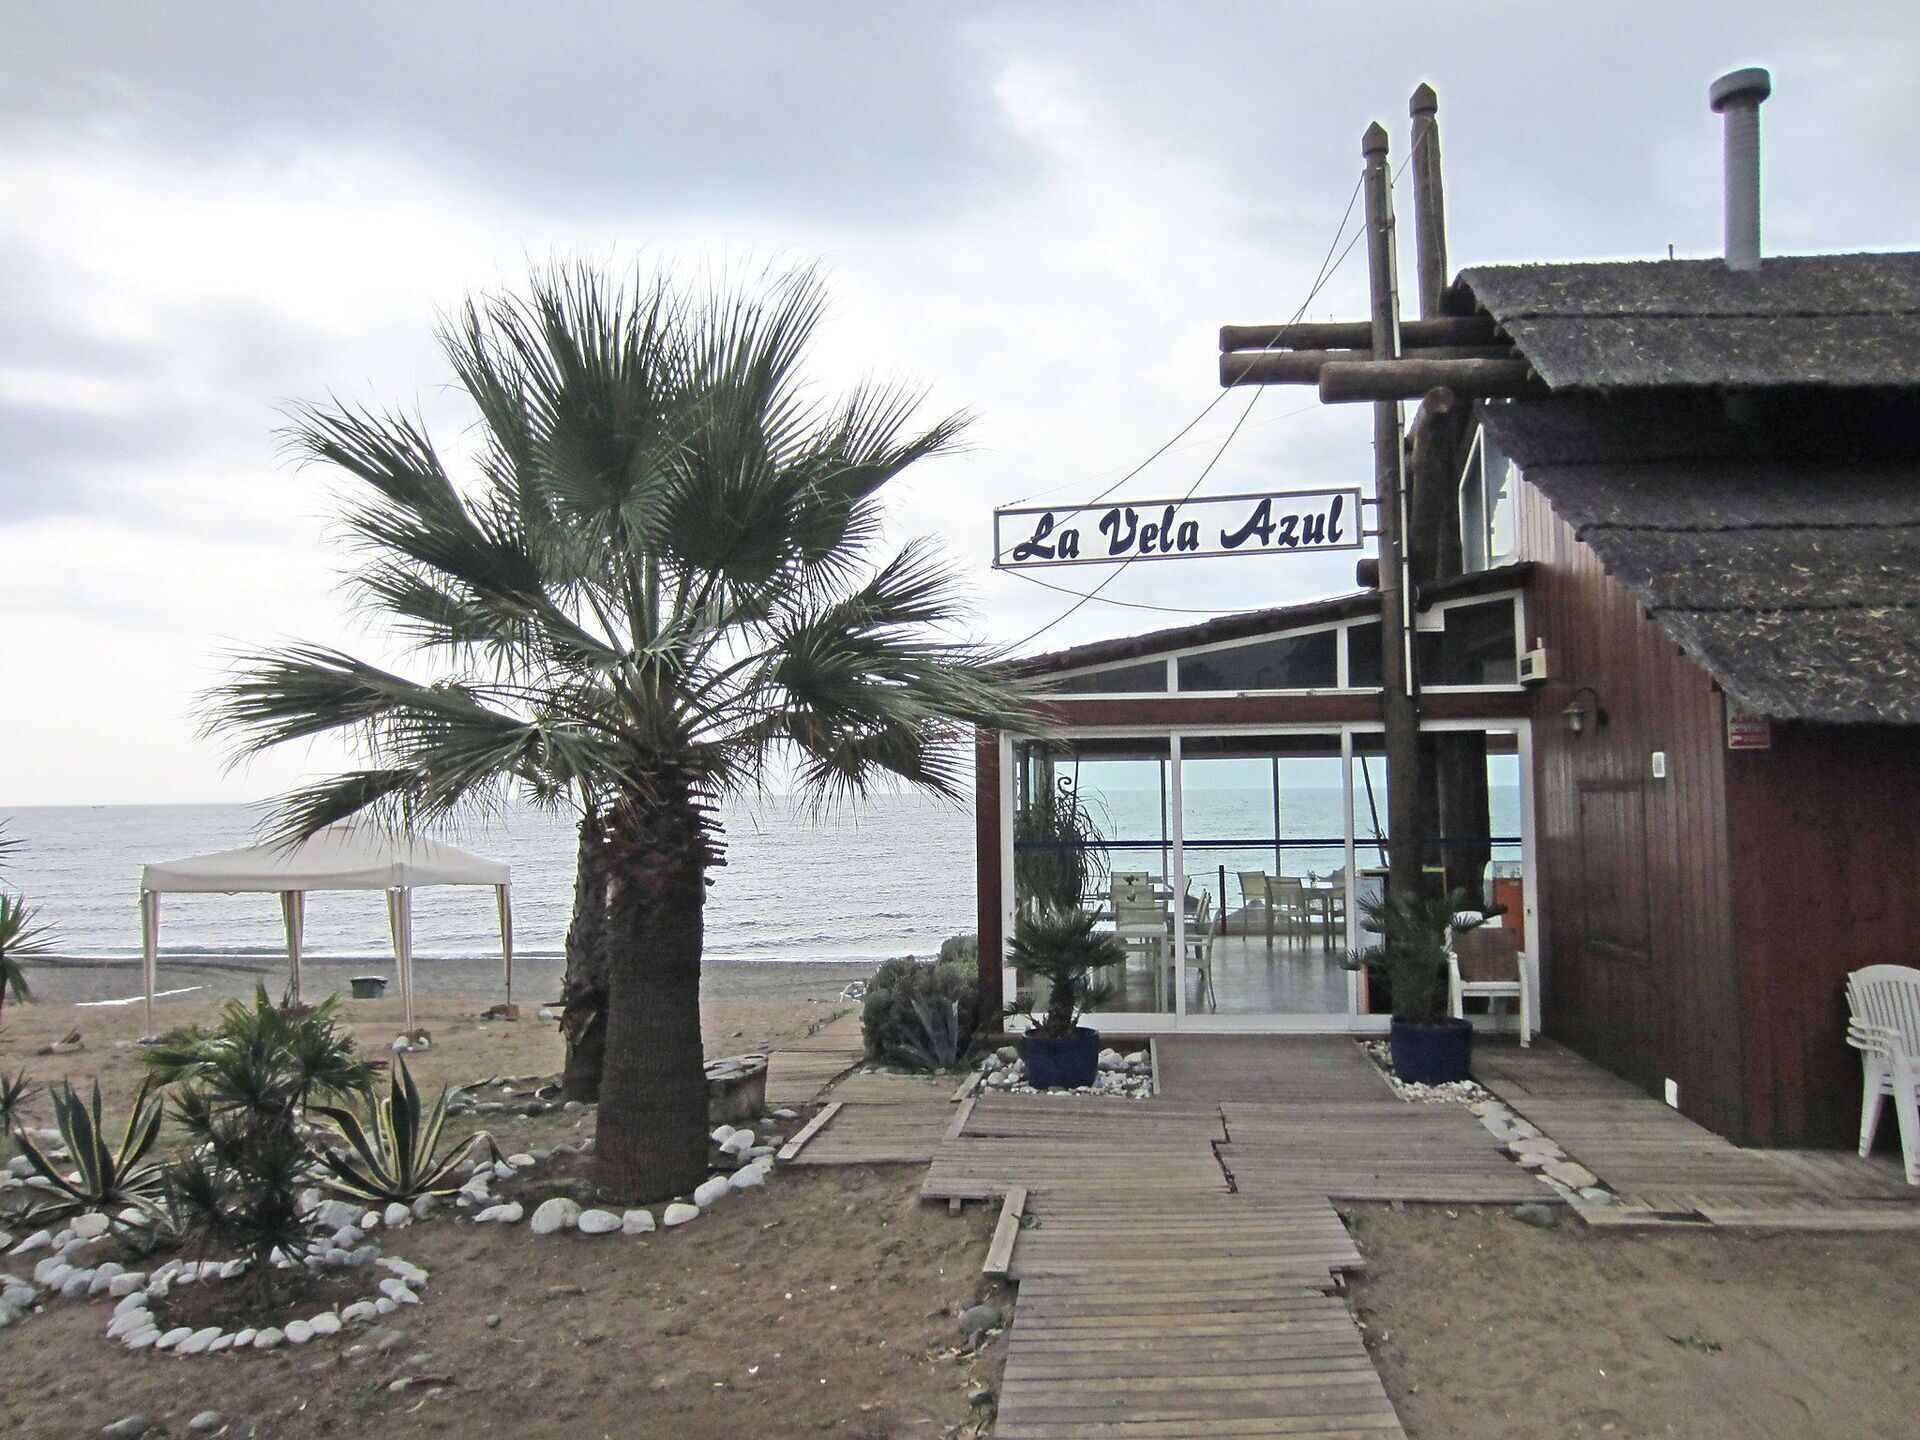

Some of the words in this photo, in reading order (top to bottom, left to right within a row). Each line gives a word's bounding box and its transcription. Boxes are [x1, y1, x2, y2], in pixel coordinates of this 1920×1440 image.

[1013, 512, 1081, 561] La
[1099, 504, 1199, 556] Vela
[1220, 494, 1343, 549] Azul
